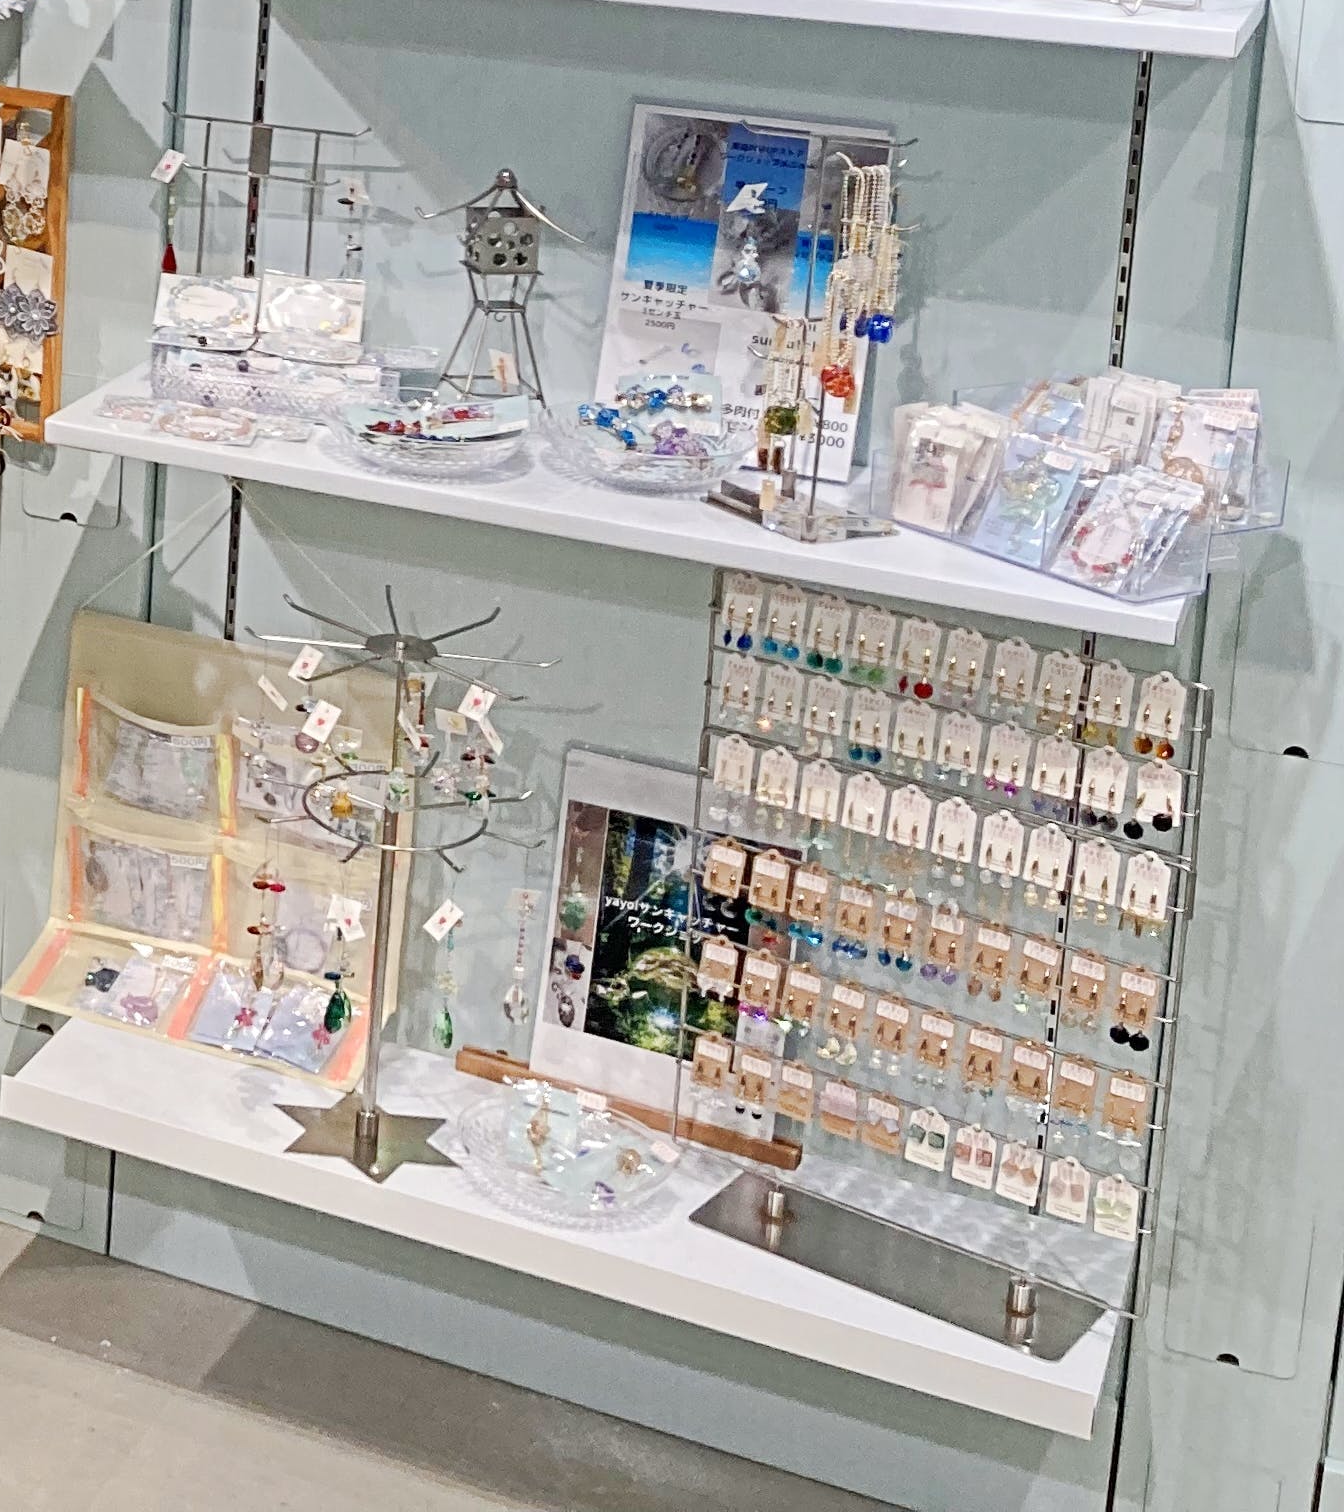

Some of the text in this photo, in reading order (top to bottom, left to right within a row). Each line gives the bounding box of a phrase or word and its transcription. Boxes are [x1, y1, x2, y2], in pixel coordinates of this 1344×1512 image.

[621, 291, 709, 311] サンキャッチャー
